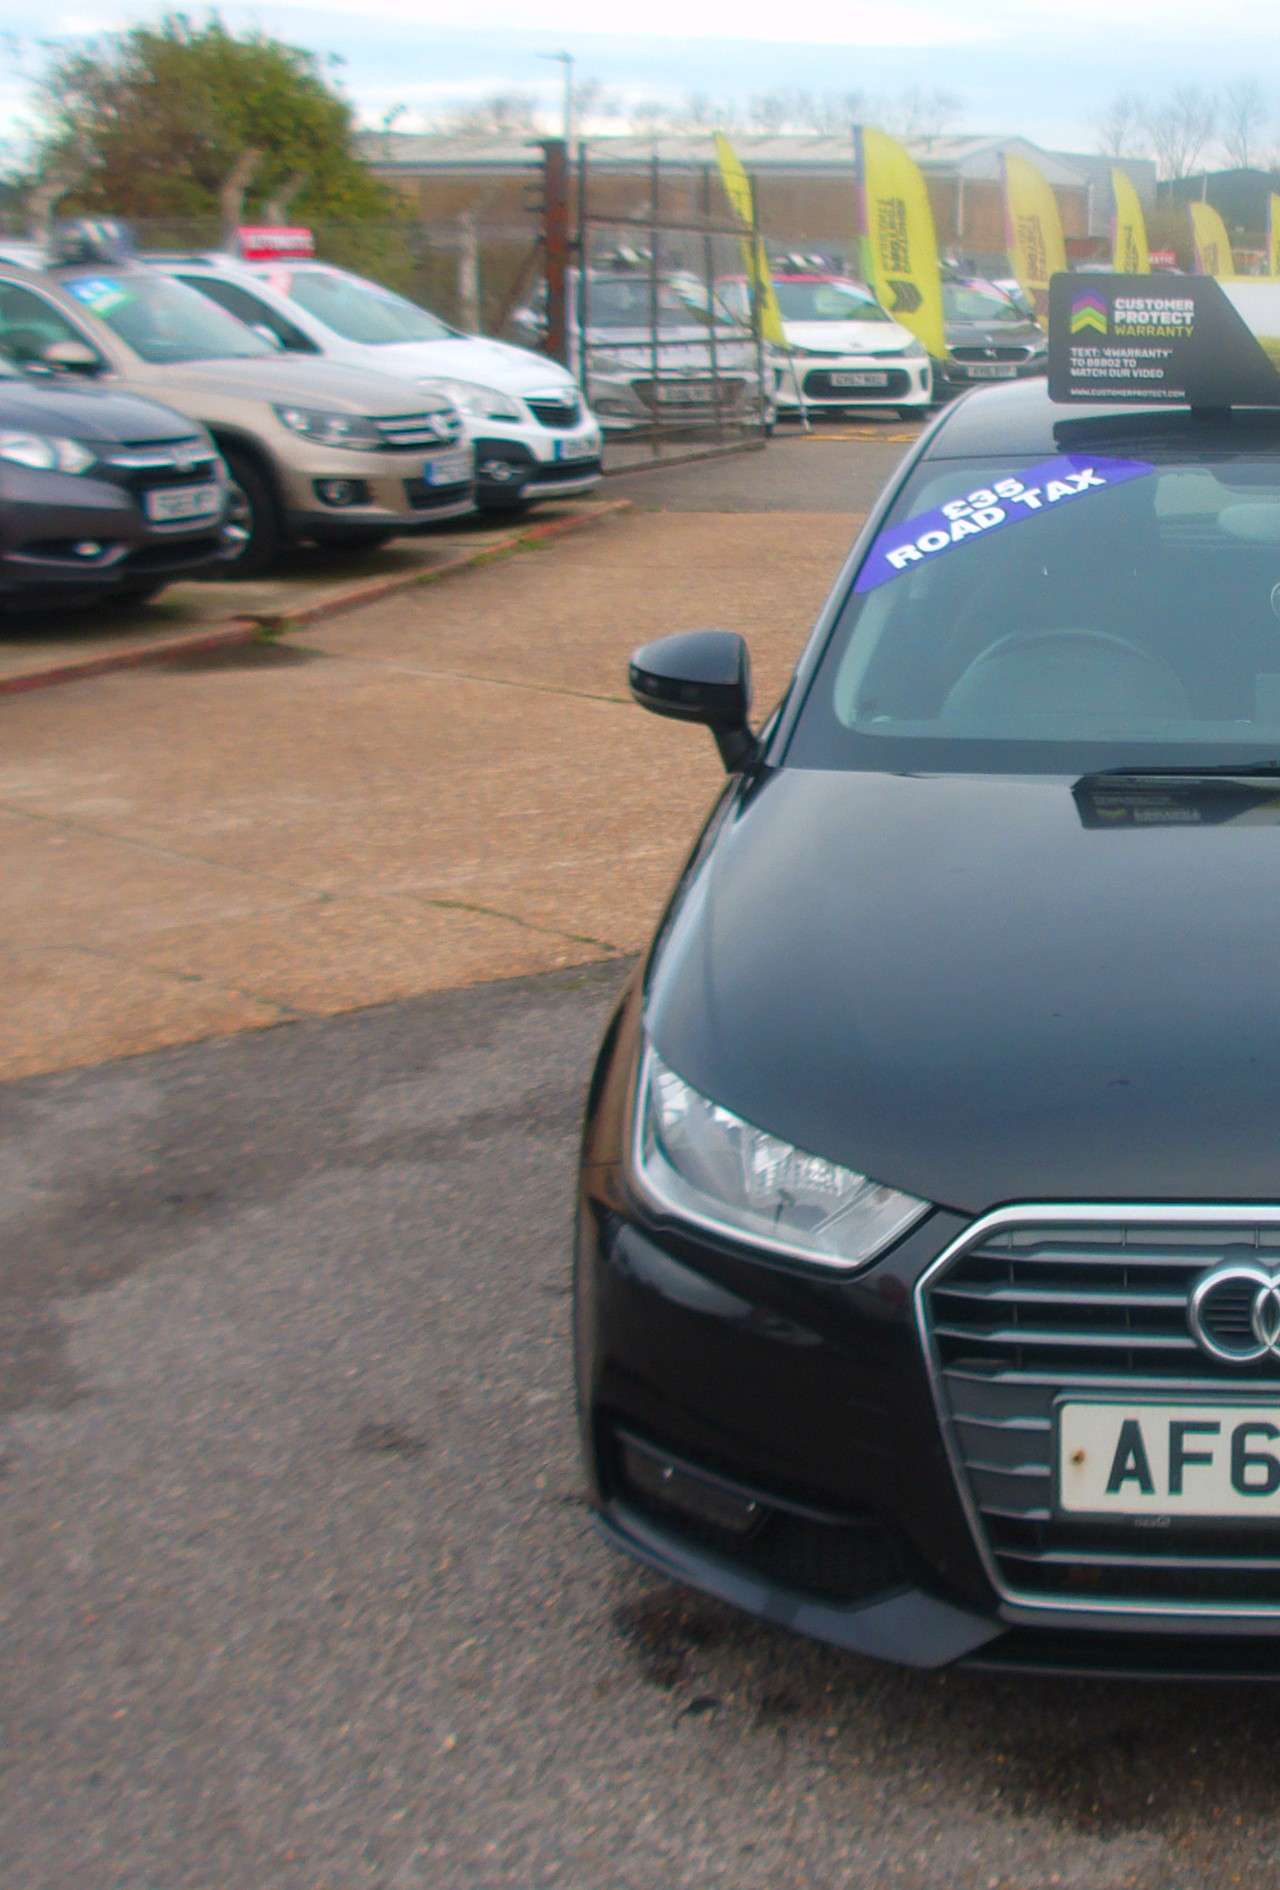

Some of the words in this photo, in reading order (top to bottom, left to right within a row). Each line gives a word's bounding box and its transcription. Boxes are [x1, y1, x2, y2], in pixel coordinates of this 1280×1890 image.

[1114, 298, 1194, 311] CUSTOMER
[1114, 311, 1195, 324] PROTECT
[1114, 325, 1194, 337] WARRANTY
[942, 477, 1026, 521] £35
[884, 507, 1006, 570] ROAD
[1010, 467, 1106, 510] TAX
